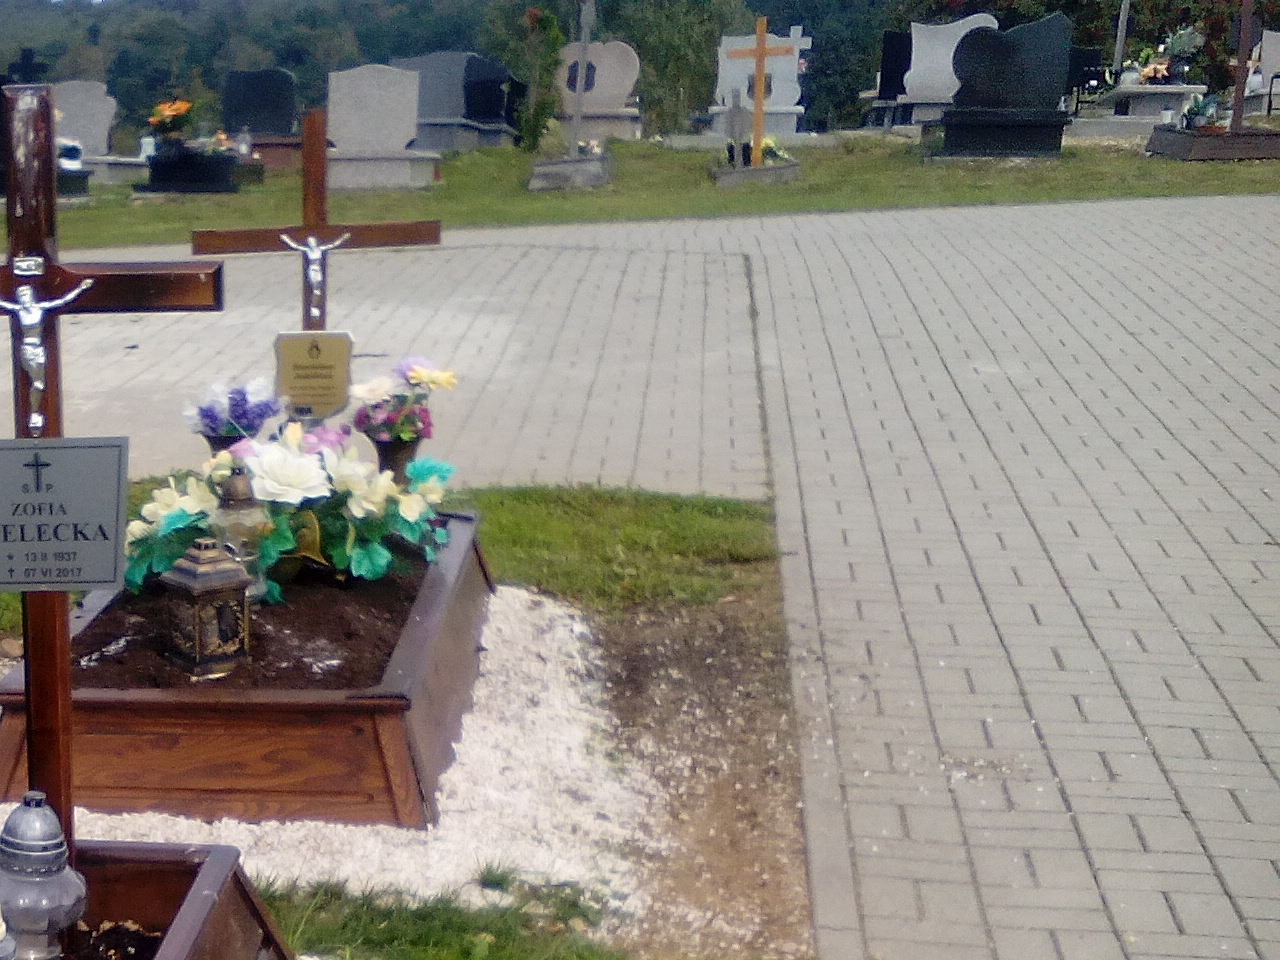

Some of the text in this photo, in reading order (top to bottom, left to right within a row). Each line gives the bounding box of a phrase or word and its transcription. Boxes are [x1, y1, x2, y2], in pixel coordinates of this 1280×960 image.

[11, 502, 68, 516] ZOFIA
[24, 552, 38, 561] 13
[41, 568, 52, 577] VI
[55, 567, 82, 577] 2017
